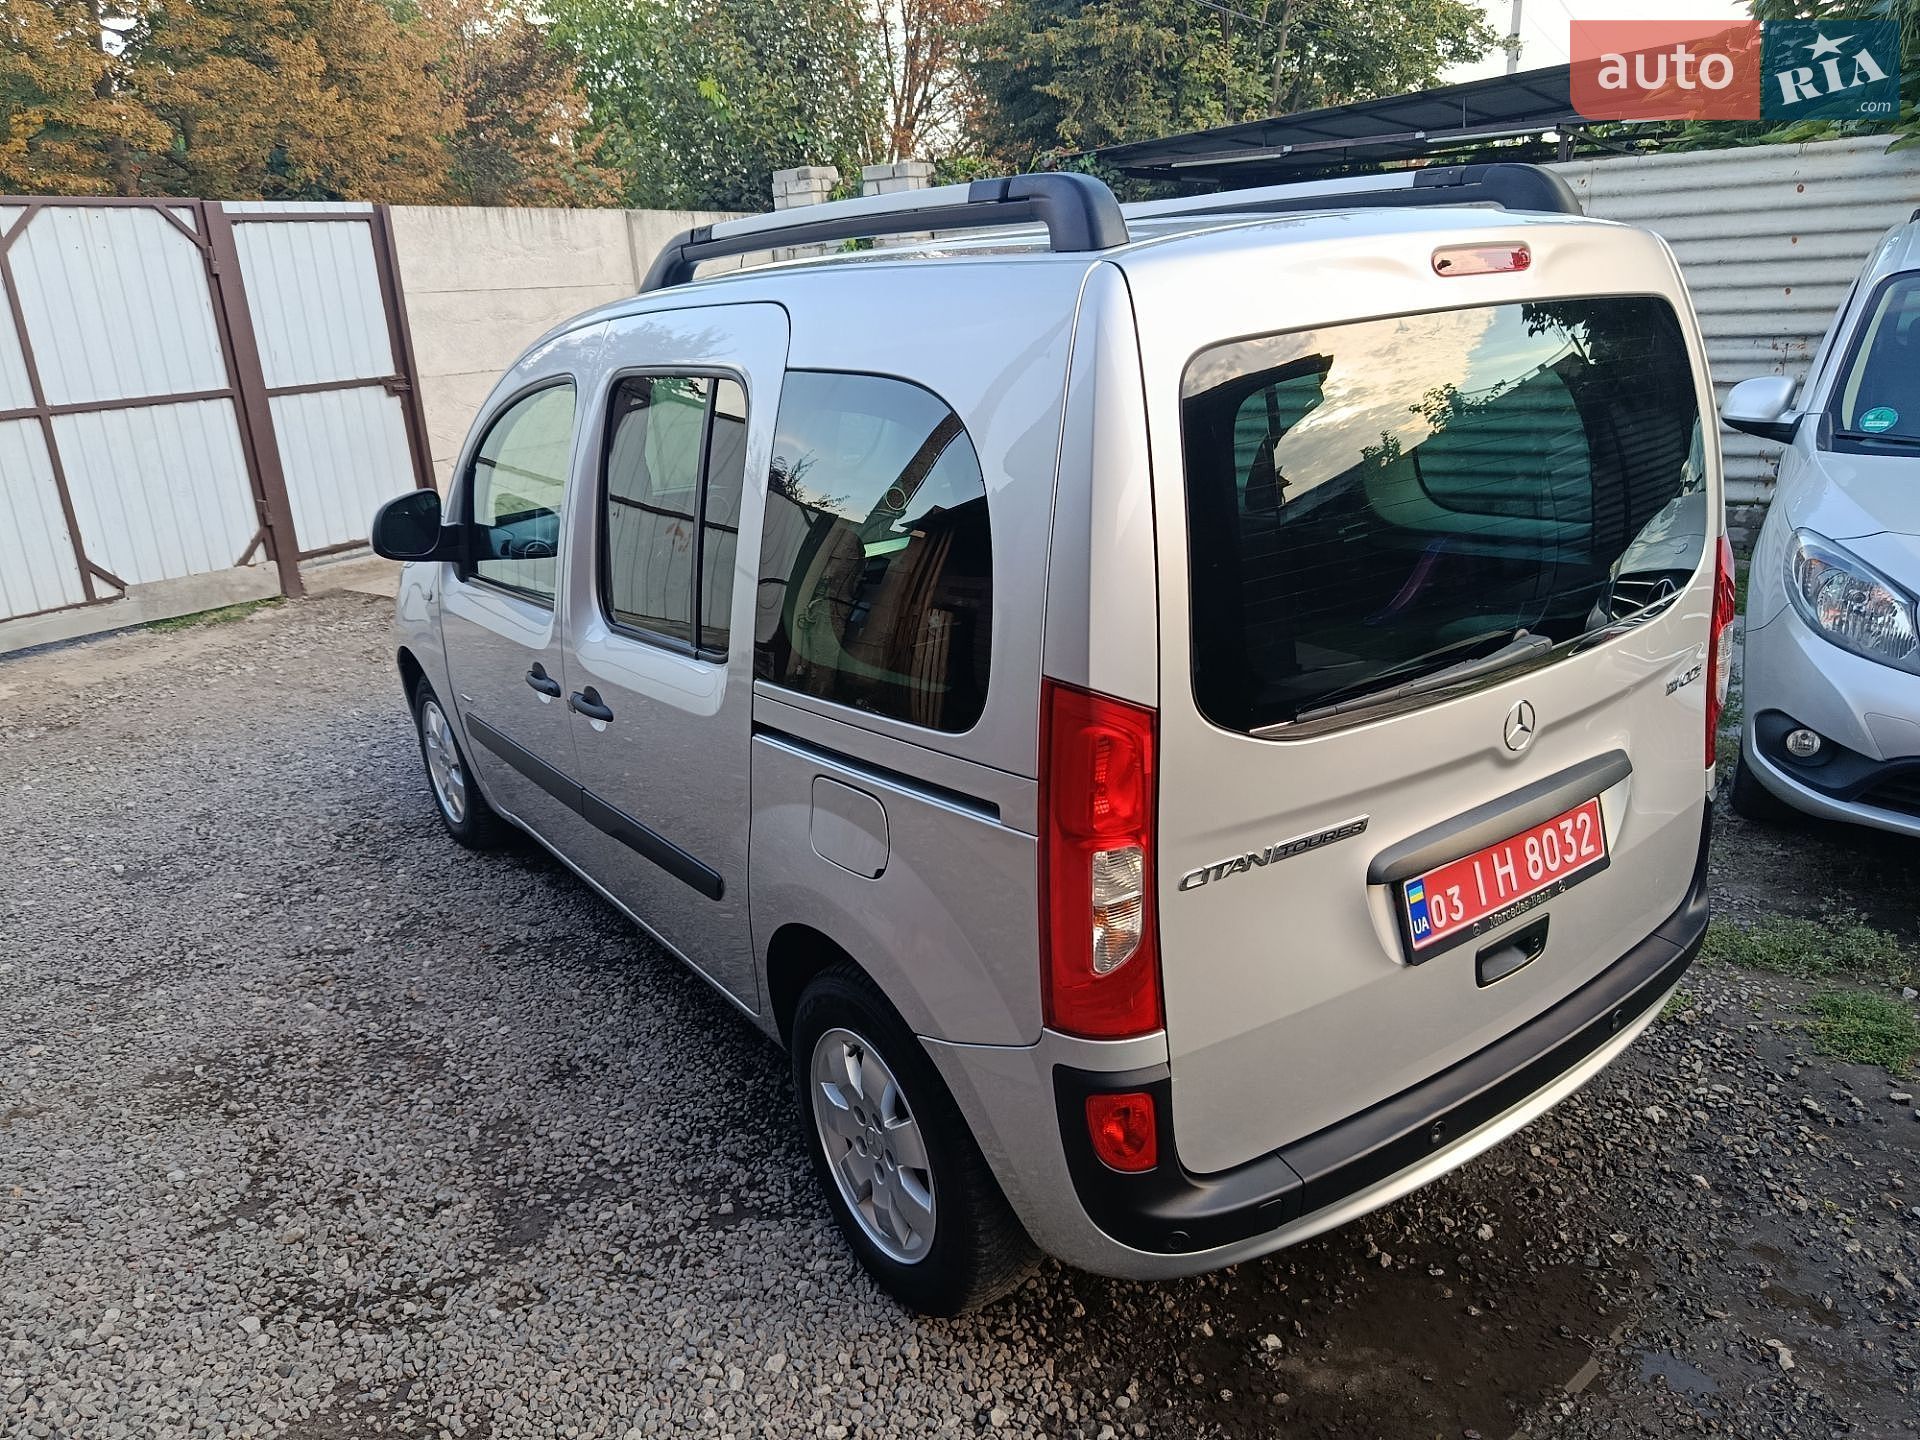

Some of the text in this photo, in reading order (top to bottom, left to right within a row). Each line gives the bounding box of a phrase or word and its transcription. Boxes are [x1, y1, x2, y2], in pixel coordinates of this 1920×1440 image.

[1178, 817, 1368, 892] CITAN TOURER
[1430, 812, 1595, 929] 03 IH 8032
[1413, 917, 1430, 934] UA
